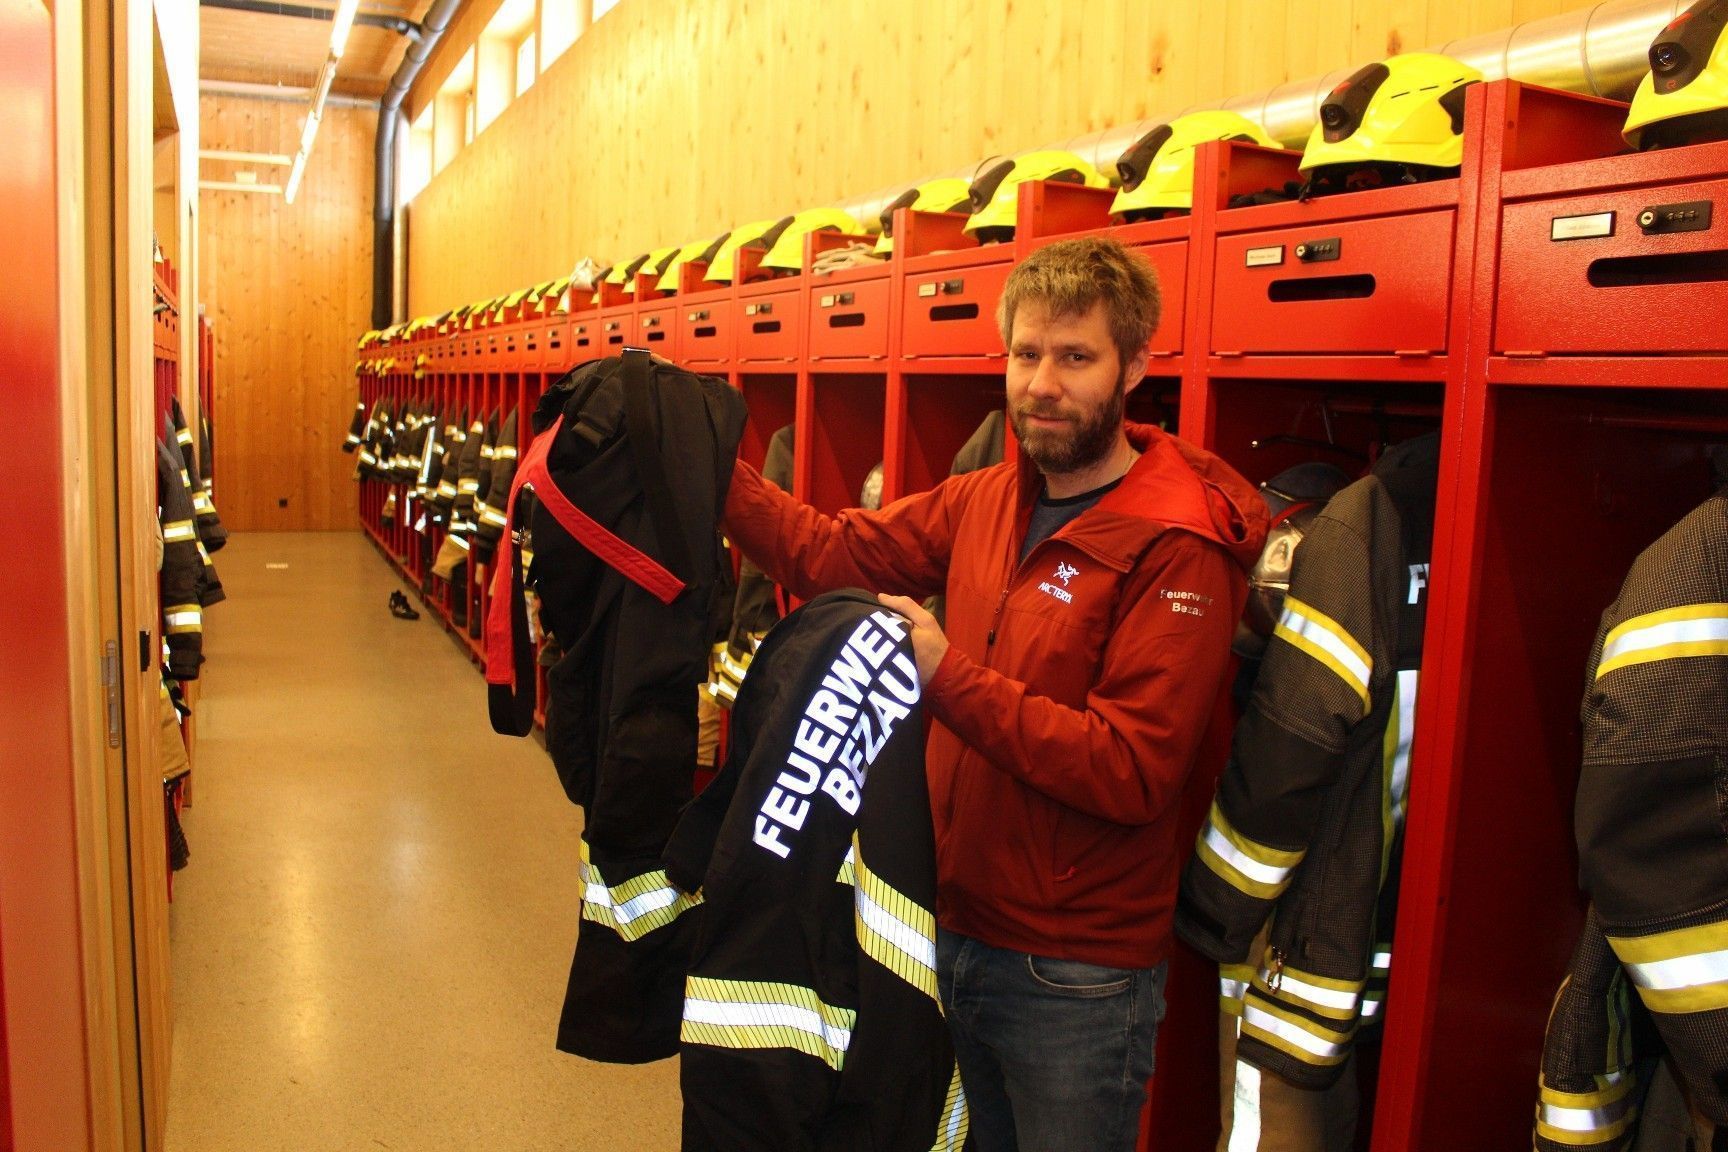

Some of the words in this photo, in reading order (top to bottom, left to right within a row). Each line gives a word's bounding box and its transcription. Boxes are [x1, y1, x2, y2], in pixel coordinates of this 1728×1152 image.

[1160, 589, 1214, 606] Feuerwr
[752, 610, 912, 859] FEUERWEH
[821, 652, 921, 816] BEZAU
